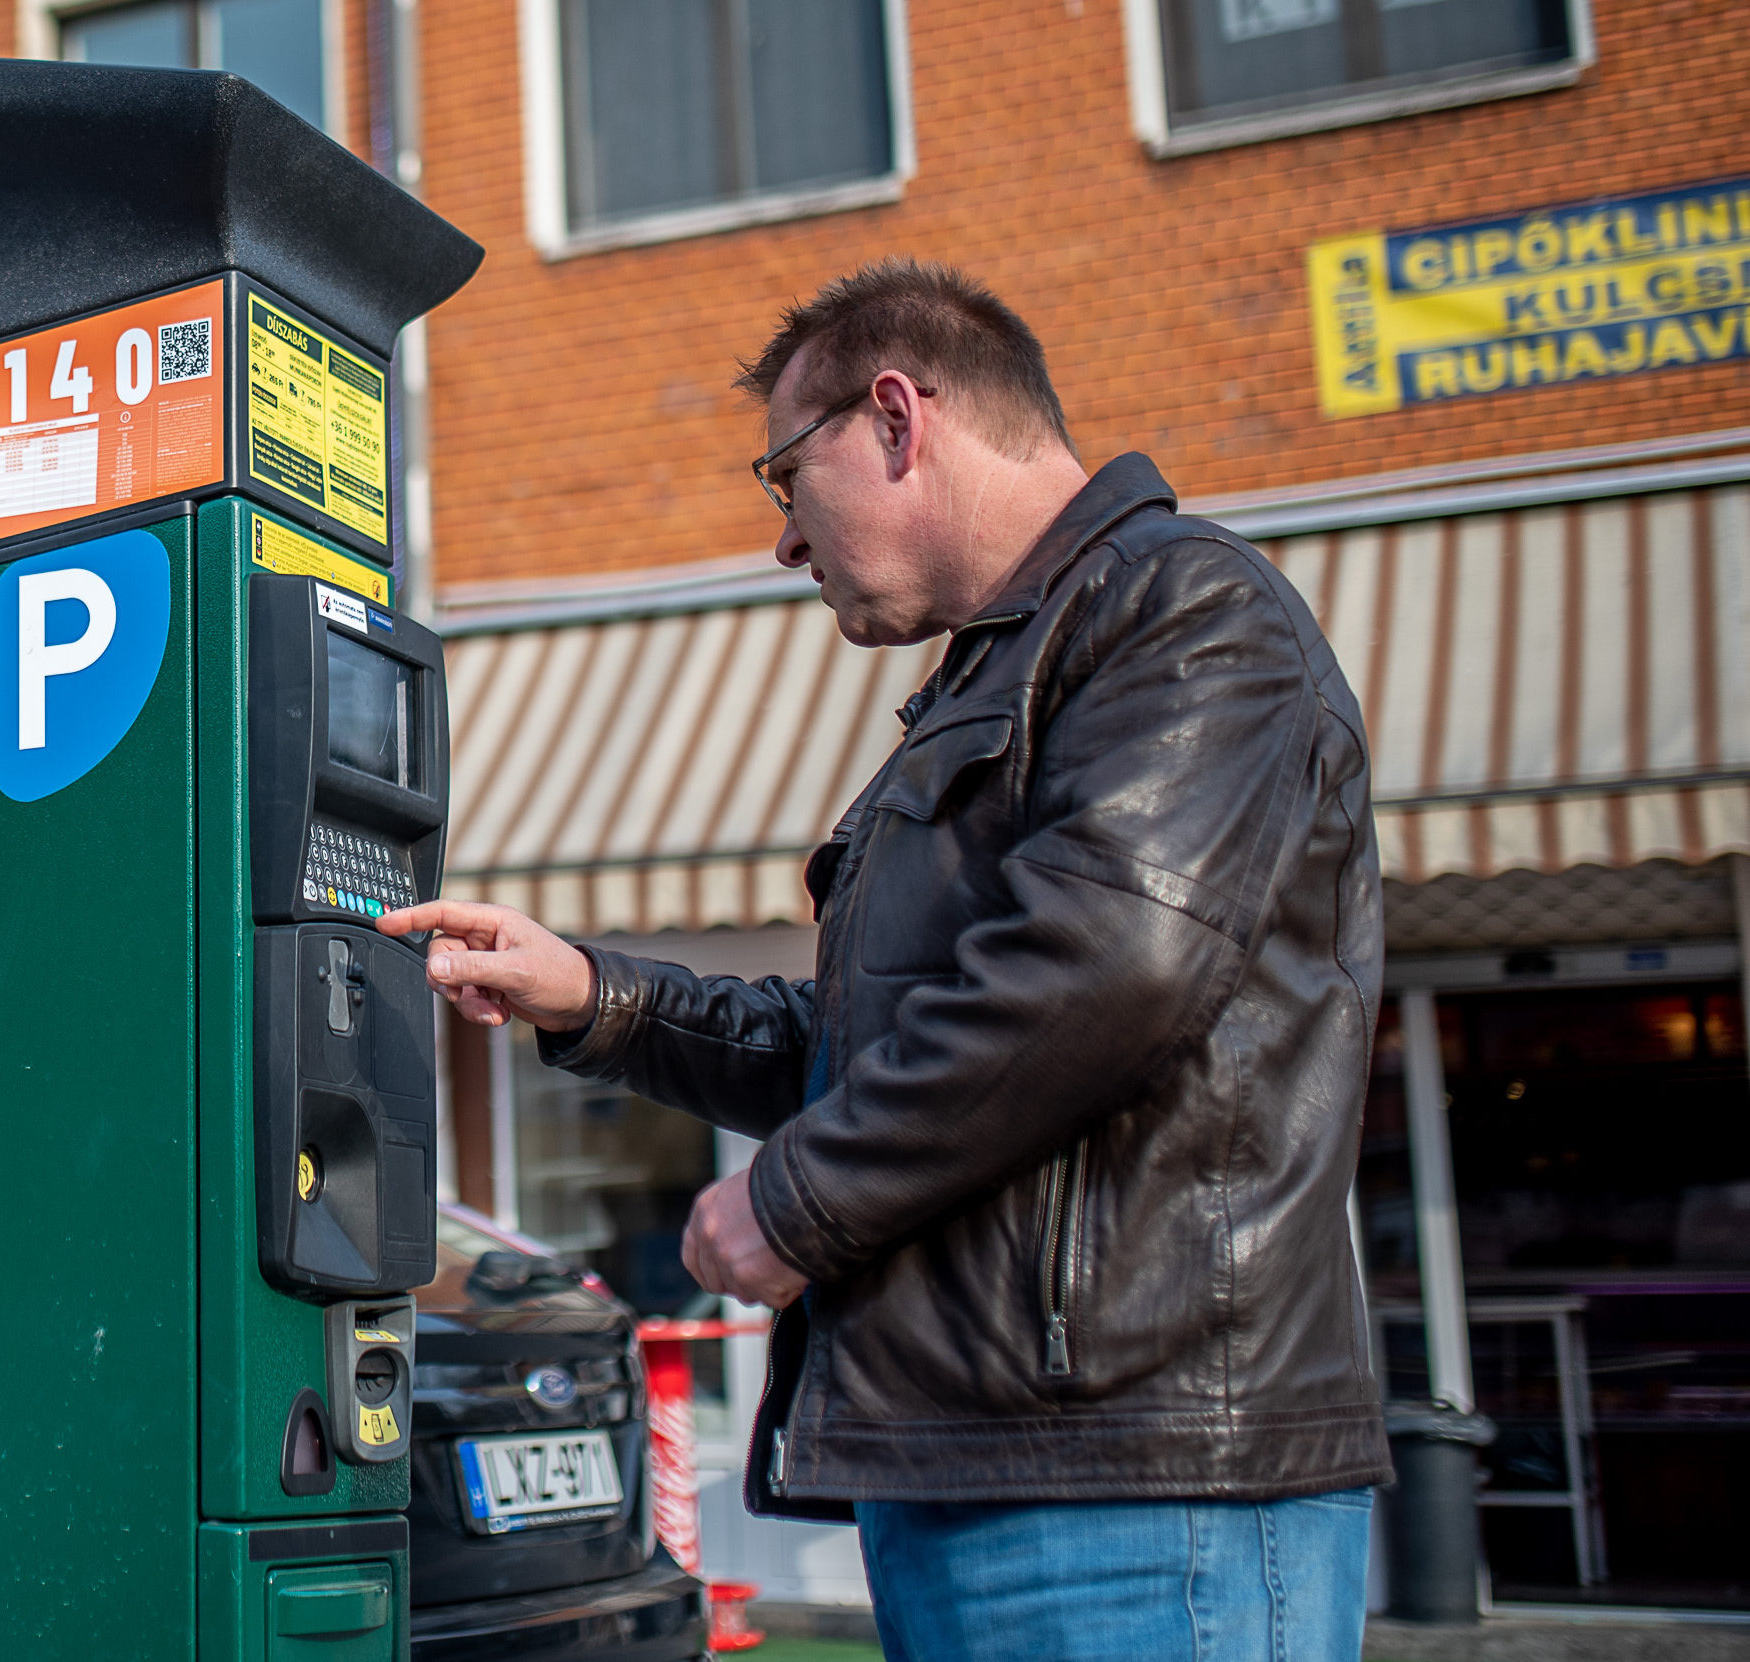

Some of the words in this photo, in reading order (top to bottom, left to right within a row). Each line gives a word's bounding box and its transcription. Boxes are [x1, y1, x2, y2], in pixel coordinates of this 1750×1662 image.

[1505, 260, 1750, 332] KULCS
[267, 314, 308, 352] DÍJSZABÁS
[19, 568, 116, 751] P
[482, 1441, 614, 1506] LXZ-971
